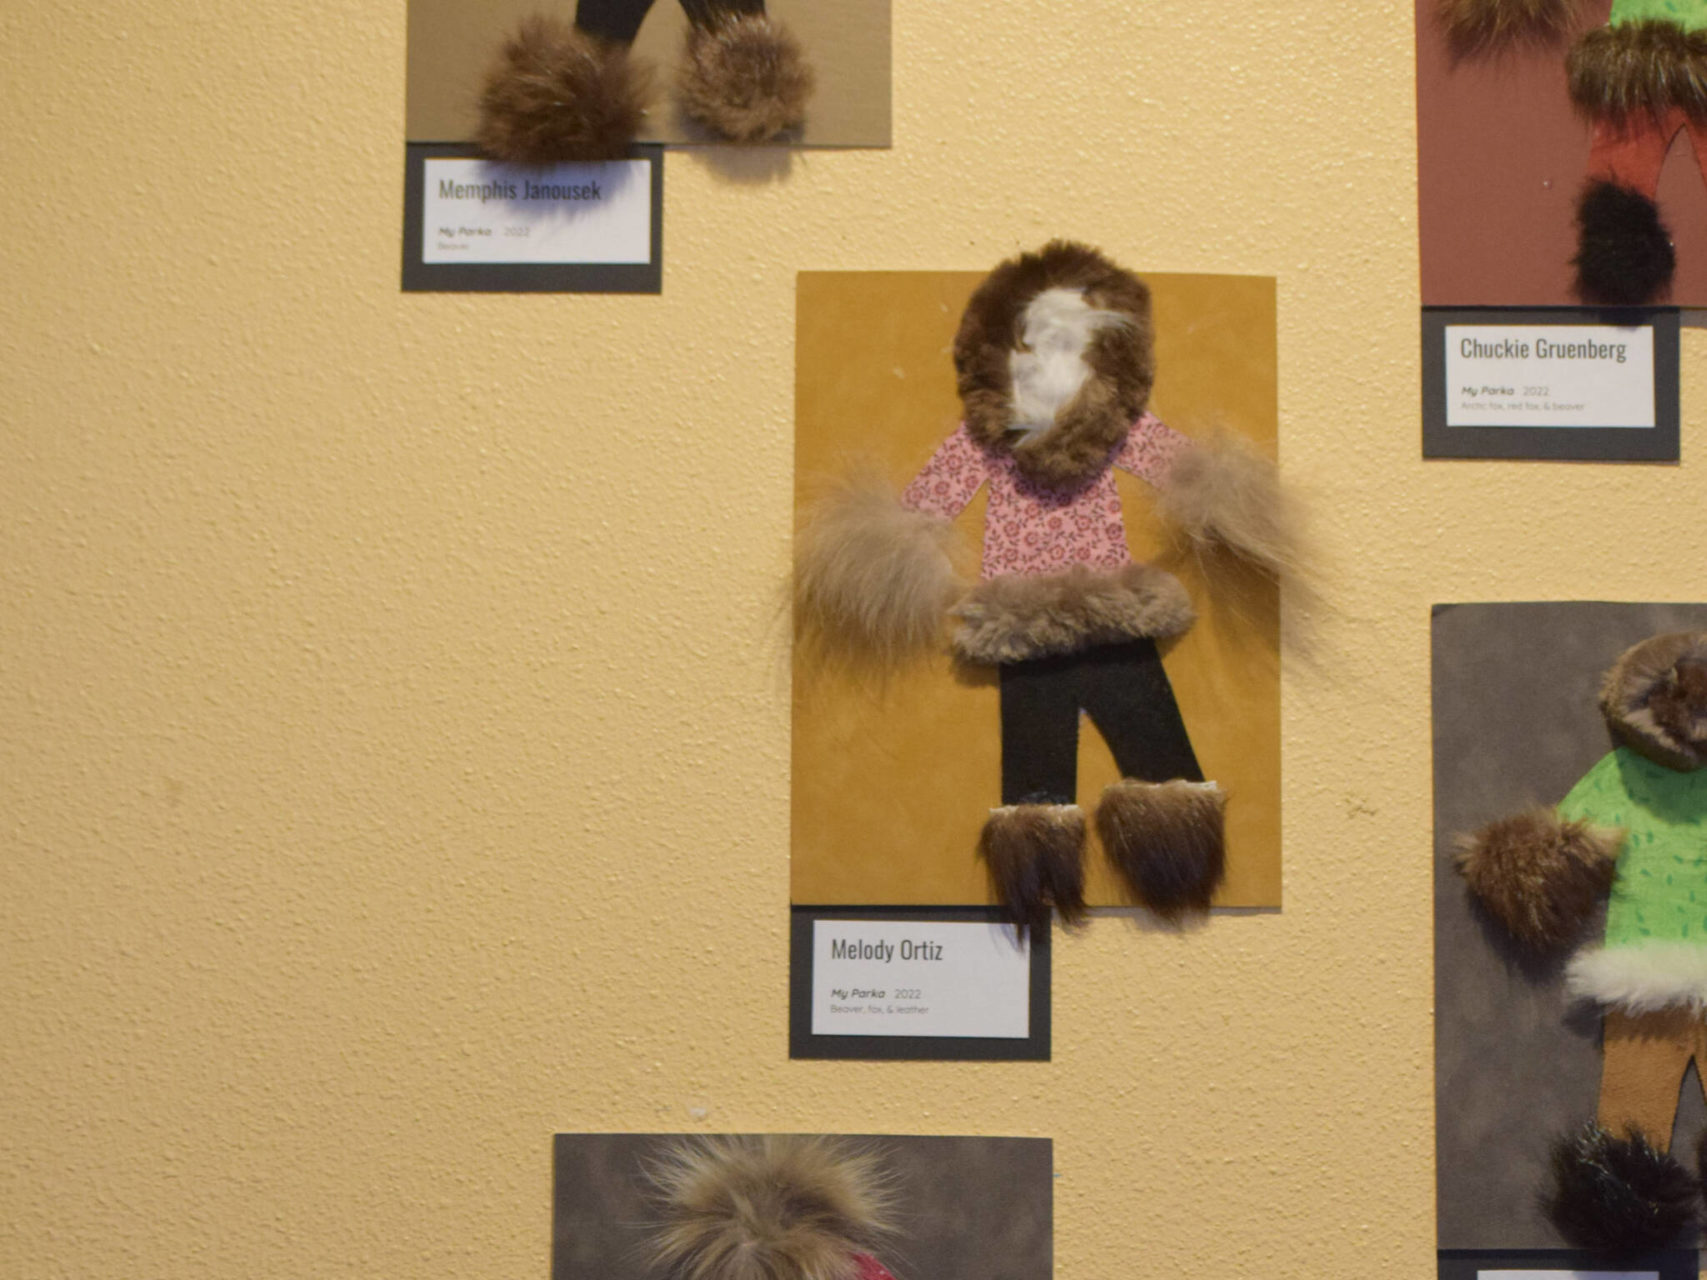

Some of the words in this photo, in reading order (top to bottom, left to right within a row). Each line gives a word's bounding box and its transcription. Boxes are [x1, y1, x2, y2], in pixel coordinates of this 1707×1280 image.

[439, 179, 517, 204] Memphis
[522, 180, 602, 200] Janousek
[438, 227, 455, 238] My
[458, 227, 493, 237] Parka
[1460, 338, 1529, 359] Chuckie
[1536, 338, 1627, 364] Gruenberg
[1461, 386, 1477, 397] My
[1481, 386, 1515, 396] Parka
[1523, 386, 1550, 397] 2022
[1507, 402, 1523, 411] red
[831, 938, 894, 963] Melody
[900, 939, 943, 961] Ortiz
[830, 988, 848, 1000] My
[851, 988, 886, 999] Parka
[895, 989, 921, 999] 2022
[887, 1005, 893, 1014] &
[896, 1005, 929, 1014] leather
